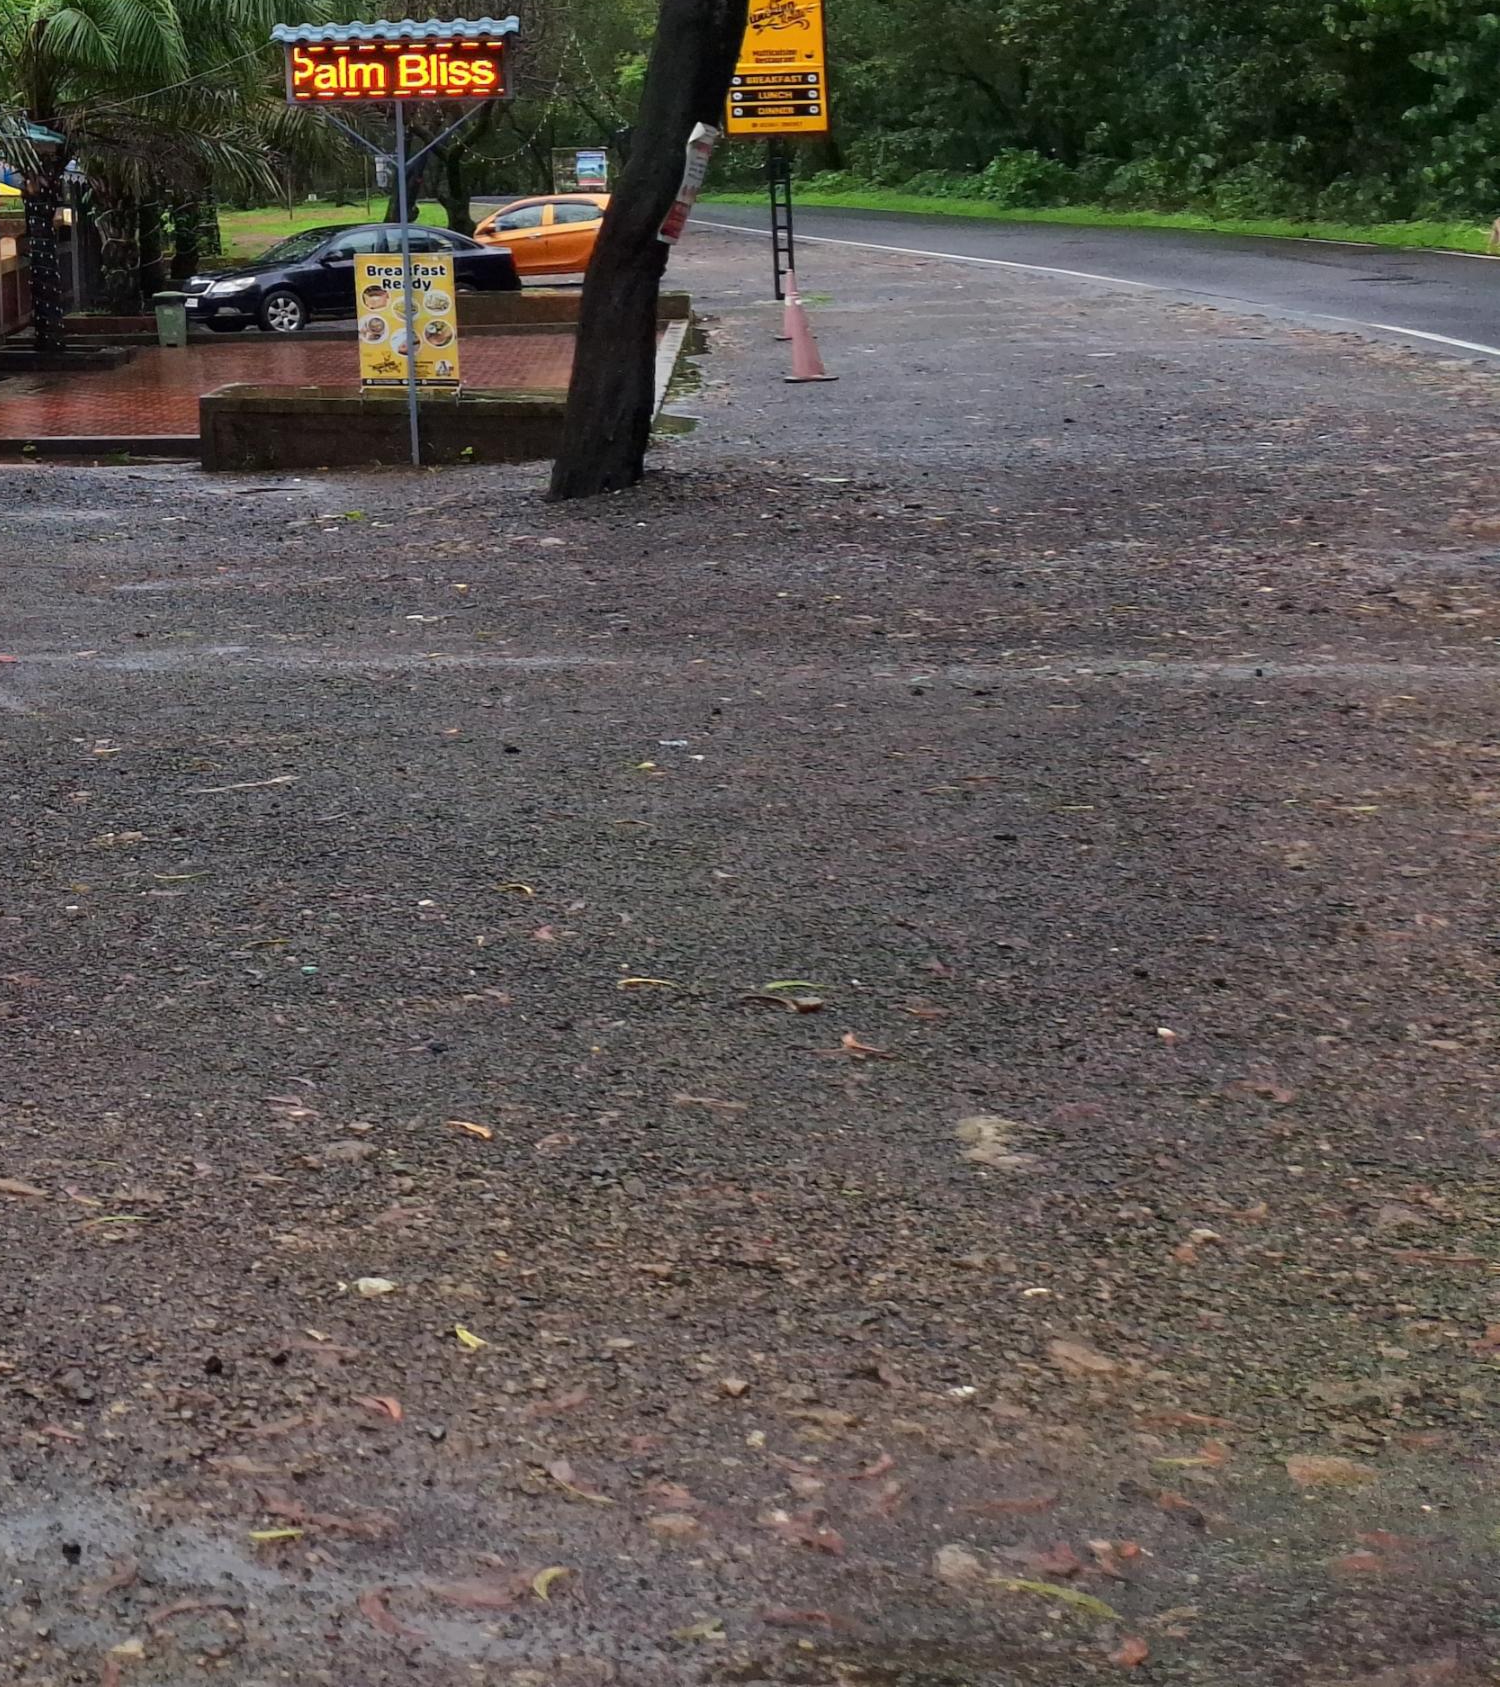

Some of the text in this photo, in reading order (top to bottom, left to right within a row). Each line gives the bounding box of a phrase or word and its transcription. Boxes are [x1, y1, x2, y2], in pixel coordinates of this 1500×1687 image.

[294, 54, 496, 88] Palm Bliss
[746, 75, 802, 84] BREAKFAST
[758, 91, 792, 99] LUNCH
[367, 264, 445, 276] Breafast
[382, 278, 432, 291] Redy
